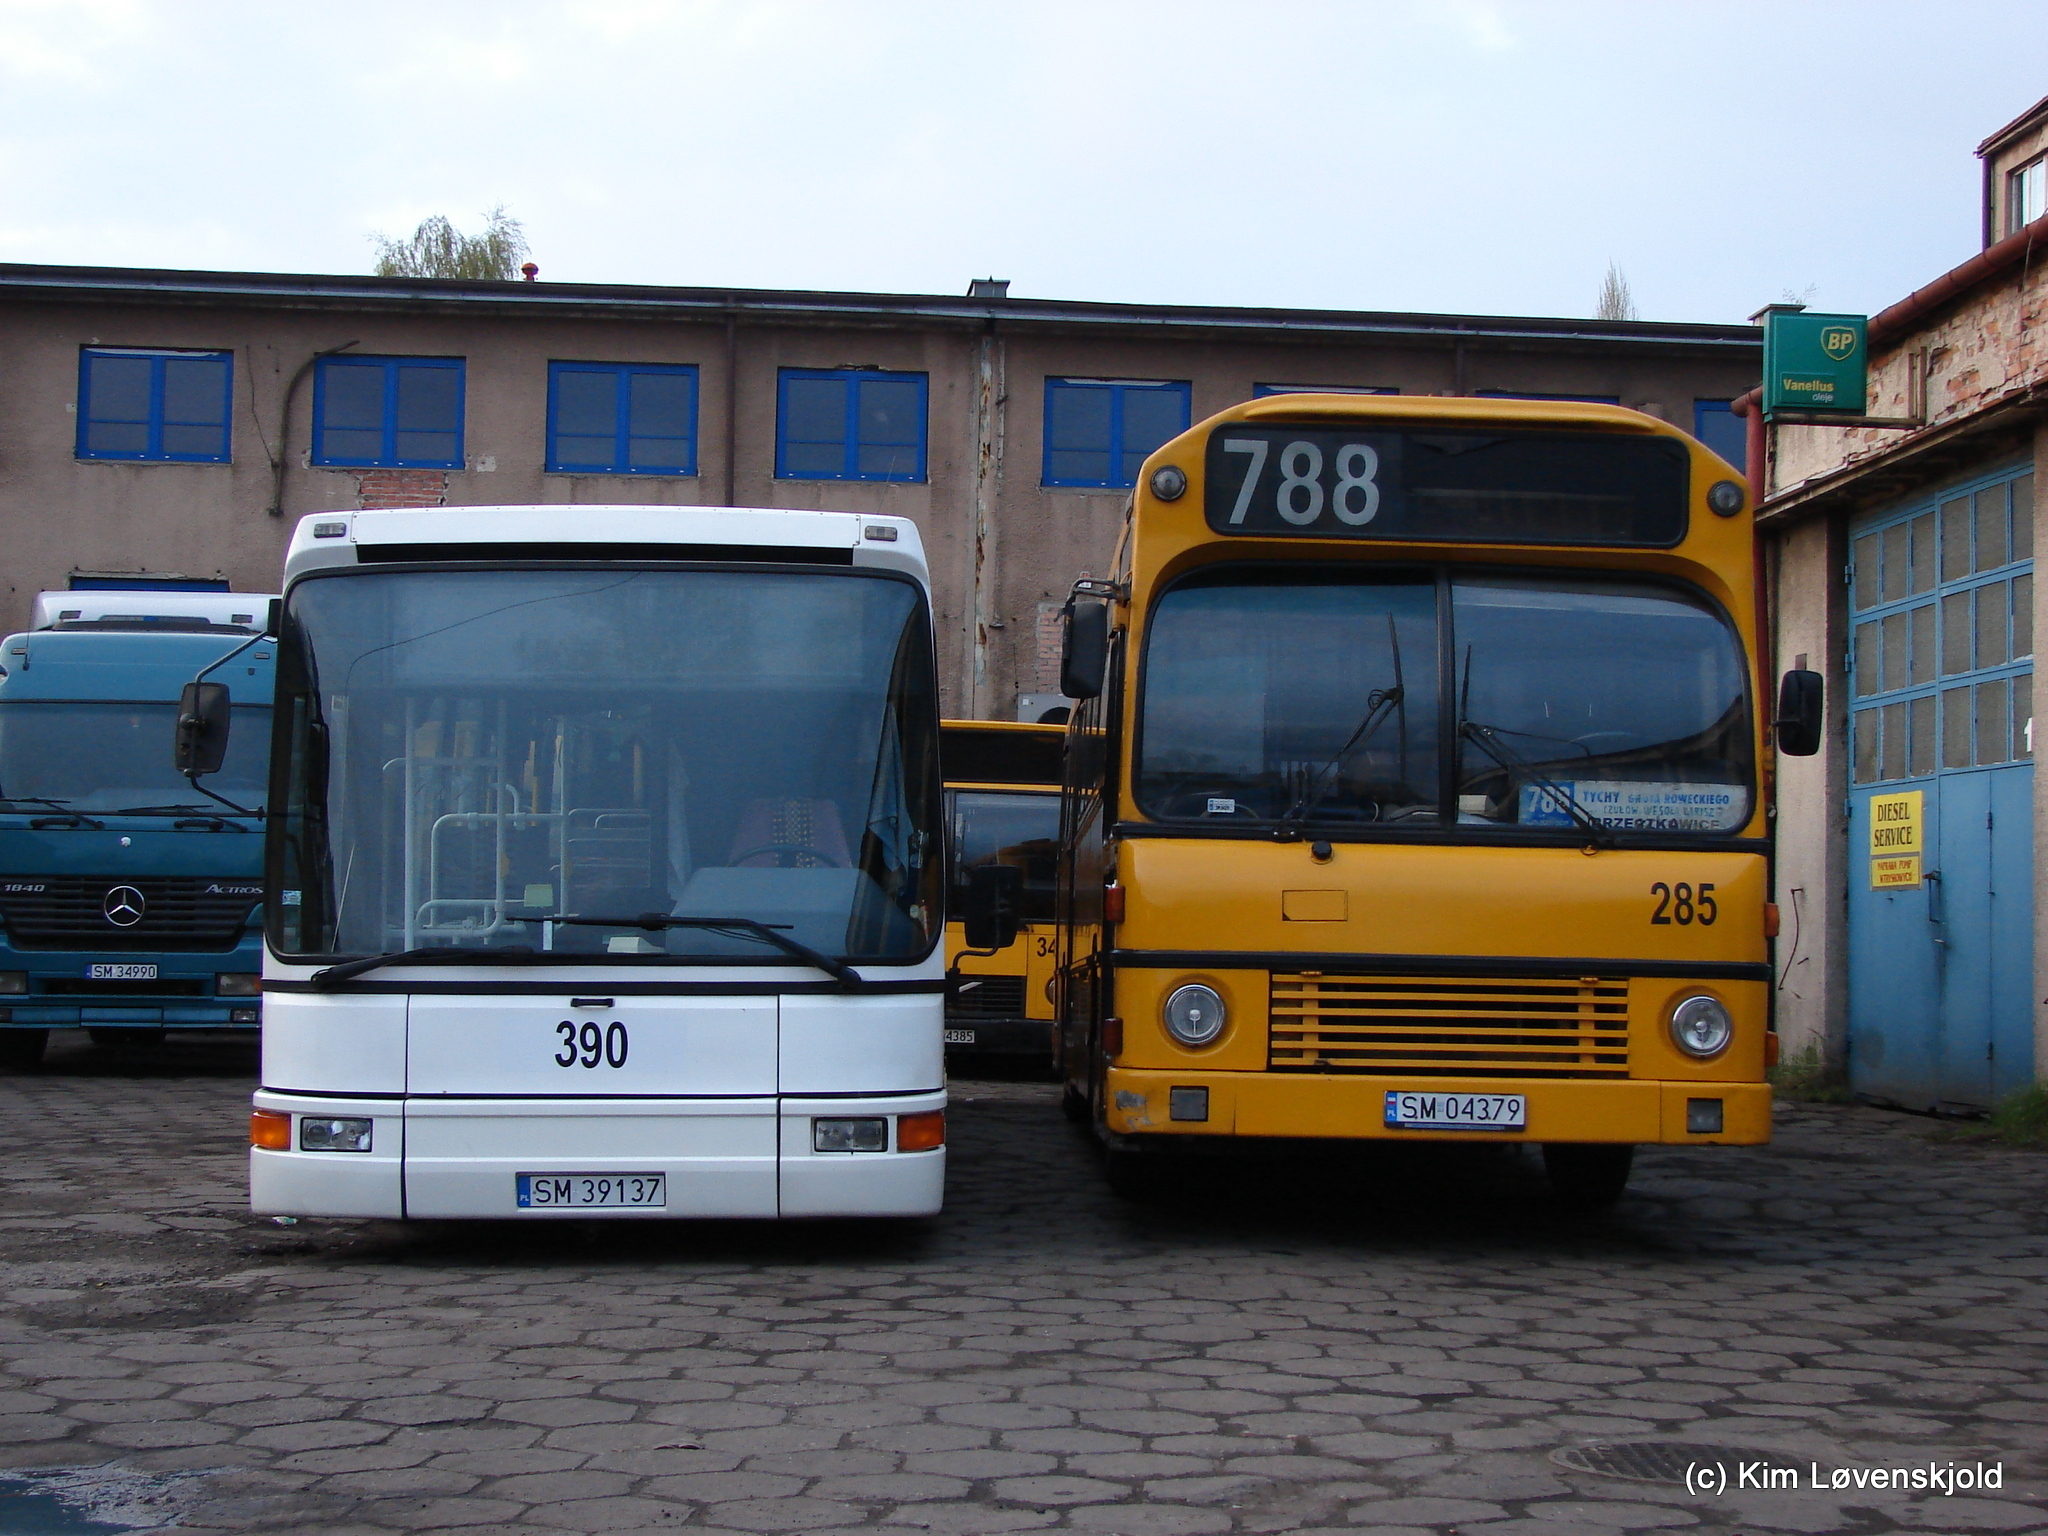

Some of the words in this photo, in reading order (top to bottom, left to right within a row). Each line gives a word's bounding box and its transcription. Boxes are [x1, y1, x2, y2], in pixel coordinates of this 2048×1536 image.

[1827, 332, 1853, 350] BP
[1783, 378, 1834, 392] Vanellus
[1812, 392, 1834, 403] oleje
[1223, 438, 1381, 527] 788
[1527, 785, 1571, 814] 788
[1583, 791, 1620, 803] TYCHY
[1664, 794, 1730, 805] ROWECKIEGO
[1877, 802, 1910, 822] DIESEL
[1874, 826, 1912, 847] SERVICE
[4, 883, 46, 892] 1840
[1649, 880, 1717, 927] 285
[94, 965, 113, 978] SM
[117, 965, 156, 978] 34990
[555, 1019, 629, 1069] 390
[943, 1030, 973, 1042] 4385
[1402, 1096, 1436, 1120] SM
[1446, 1097, 1520, 1121] 04379
[520, 1194, 530, 1202] PL
[534, 1179, 572, 1203] SM
[581, 1178, 661, 1203] 39137
